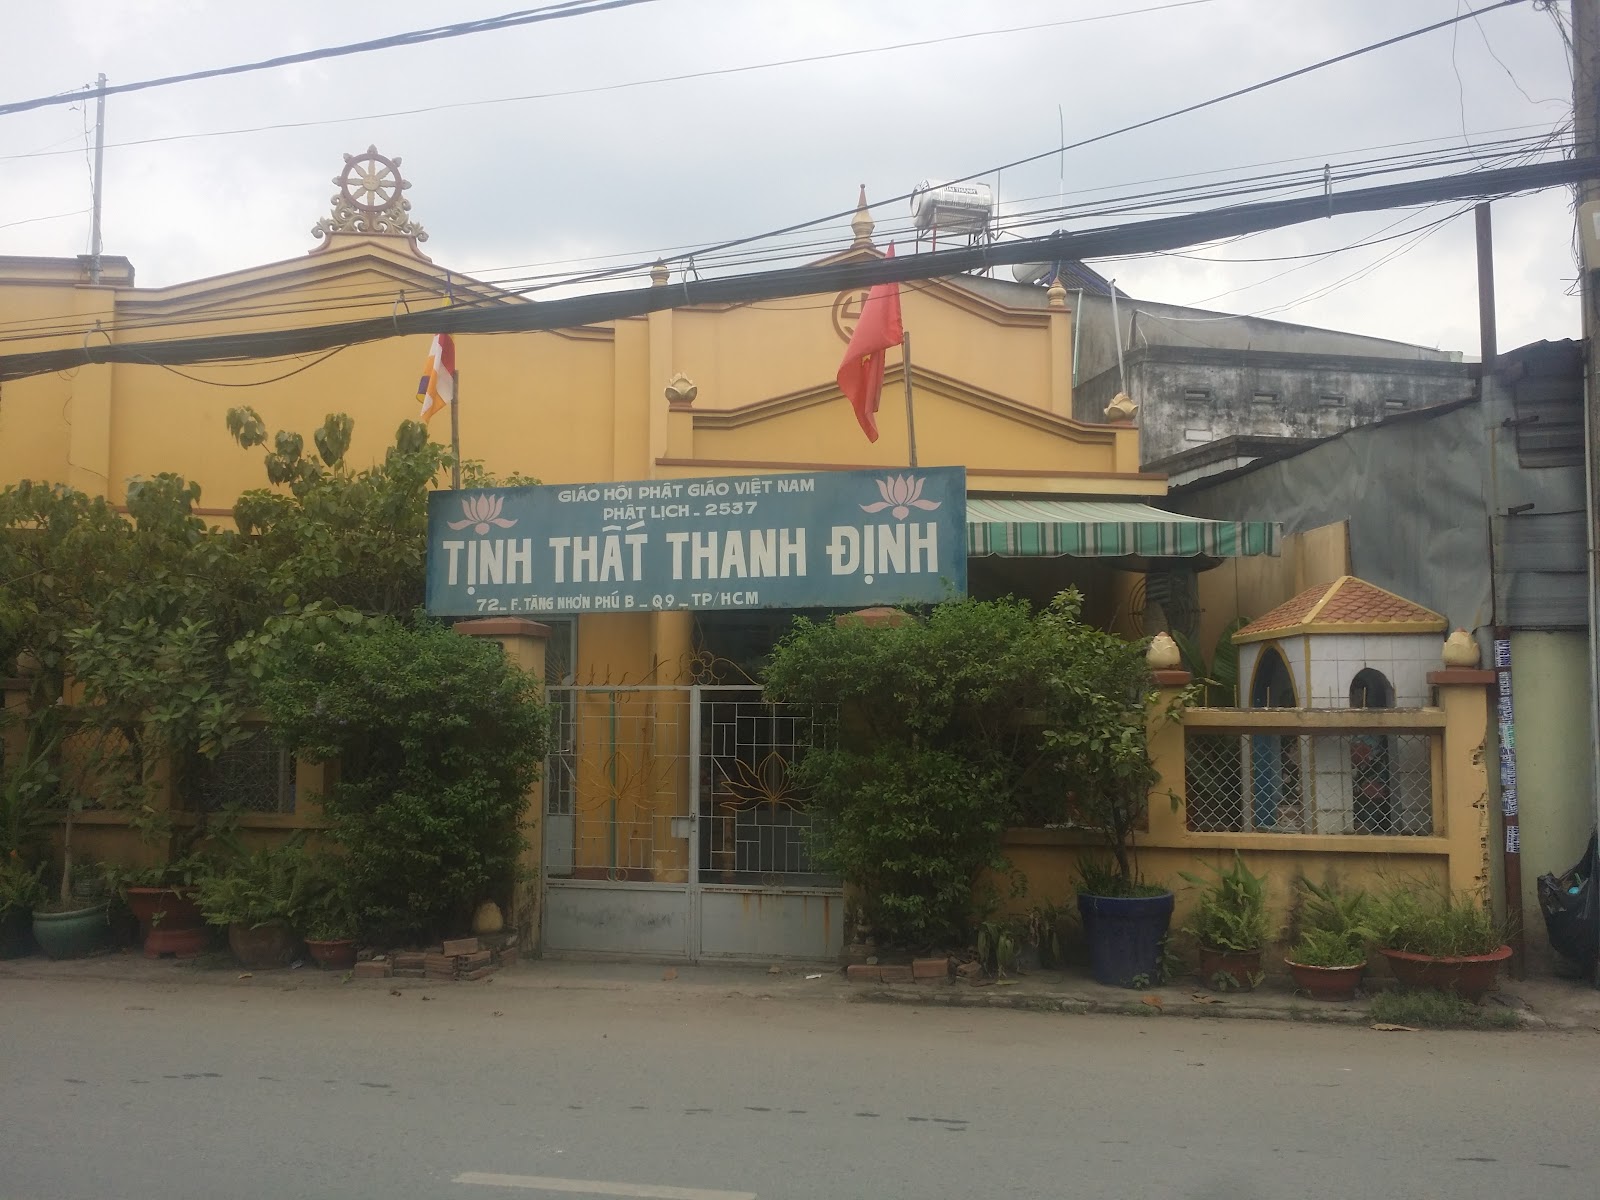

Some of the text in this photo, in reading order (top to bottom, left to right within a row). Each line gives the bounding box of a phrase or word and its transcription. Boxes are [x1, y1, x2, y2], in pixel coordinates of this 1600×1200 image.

[557, 477, 815, 504] GIÁO HỘI PHẬT GIÁO VIỆT NAM
[604, 503, 646, 521] PHẬT
[650, 504, 690, 520] LỊCH
[705, 500, 758, 517] 2537
[442, 520, 939, 596] TỊNH THẤT THANH ĐỊNH
[510, 598, 523, 611] F.
[524, 594, 554, 611] TĂNG
[557, 593, 591, 610] NHƠN
[594, 590, 619, 609] PHÚ
[624, 595, 634, 608] B
[691, 591, 759, 608] TP/HCM
